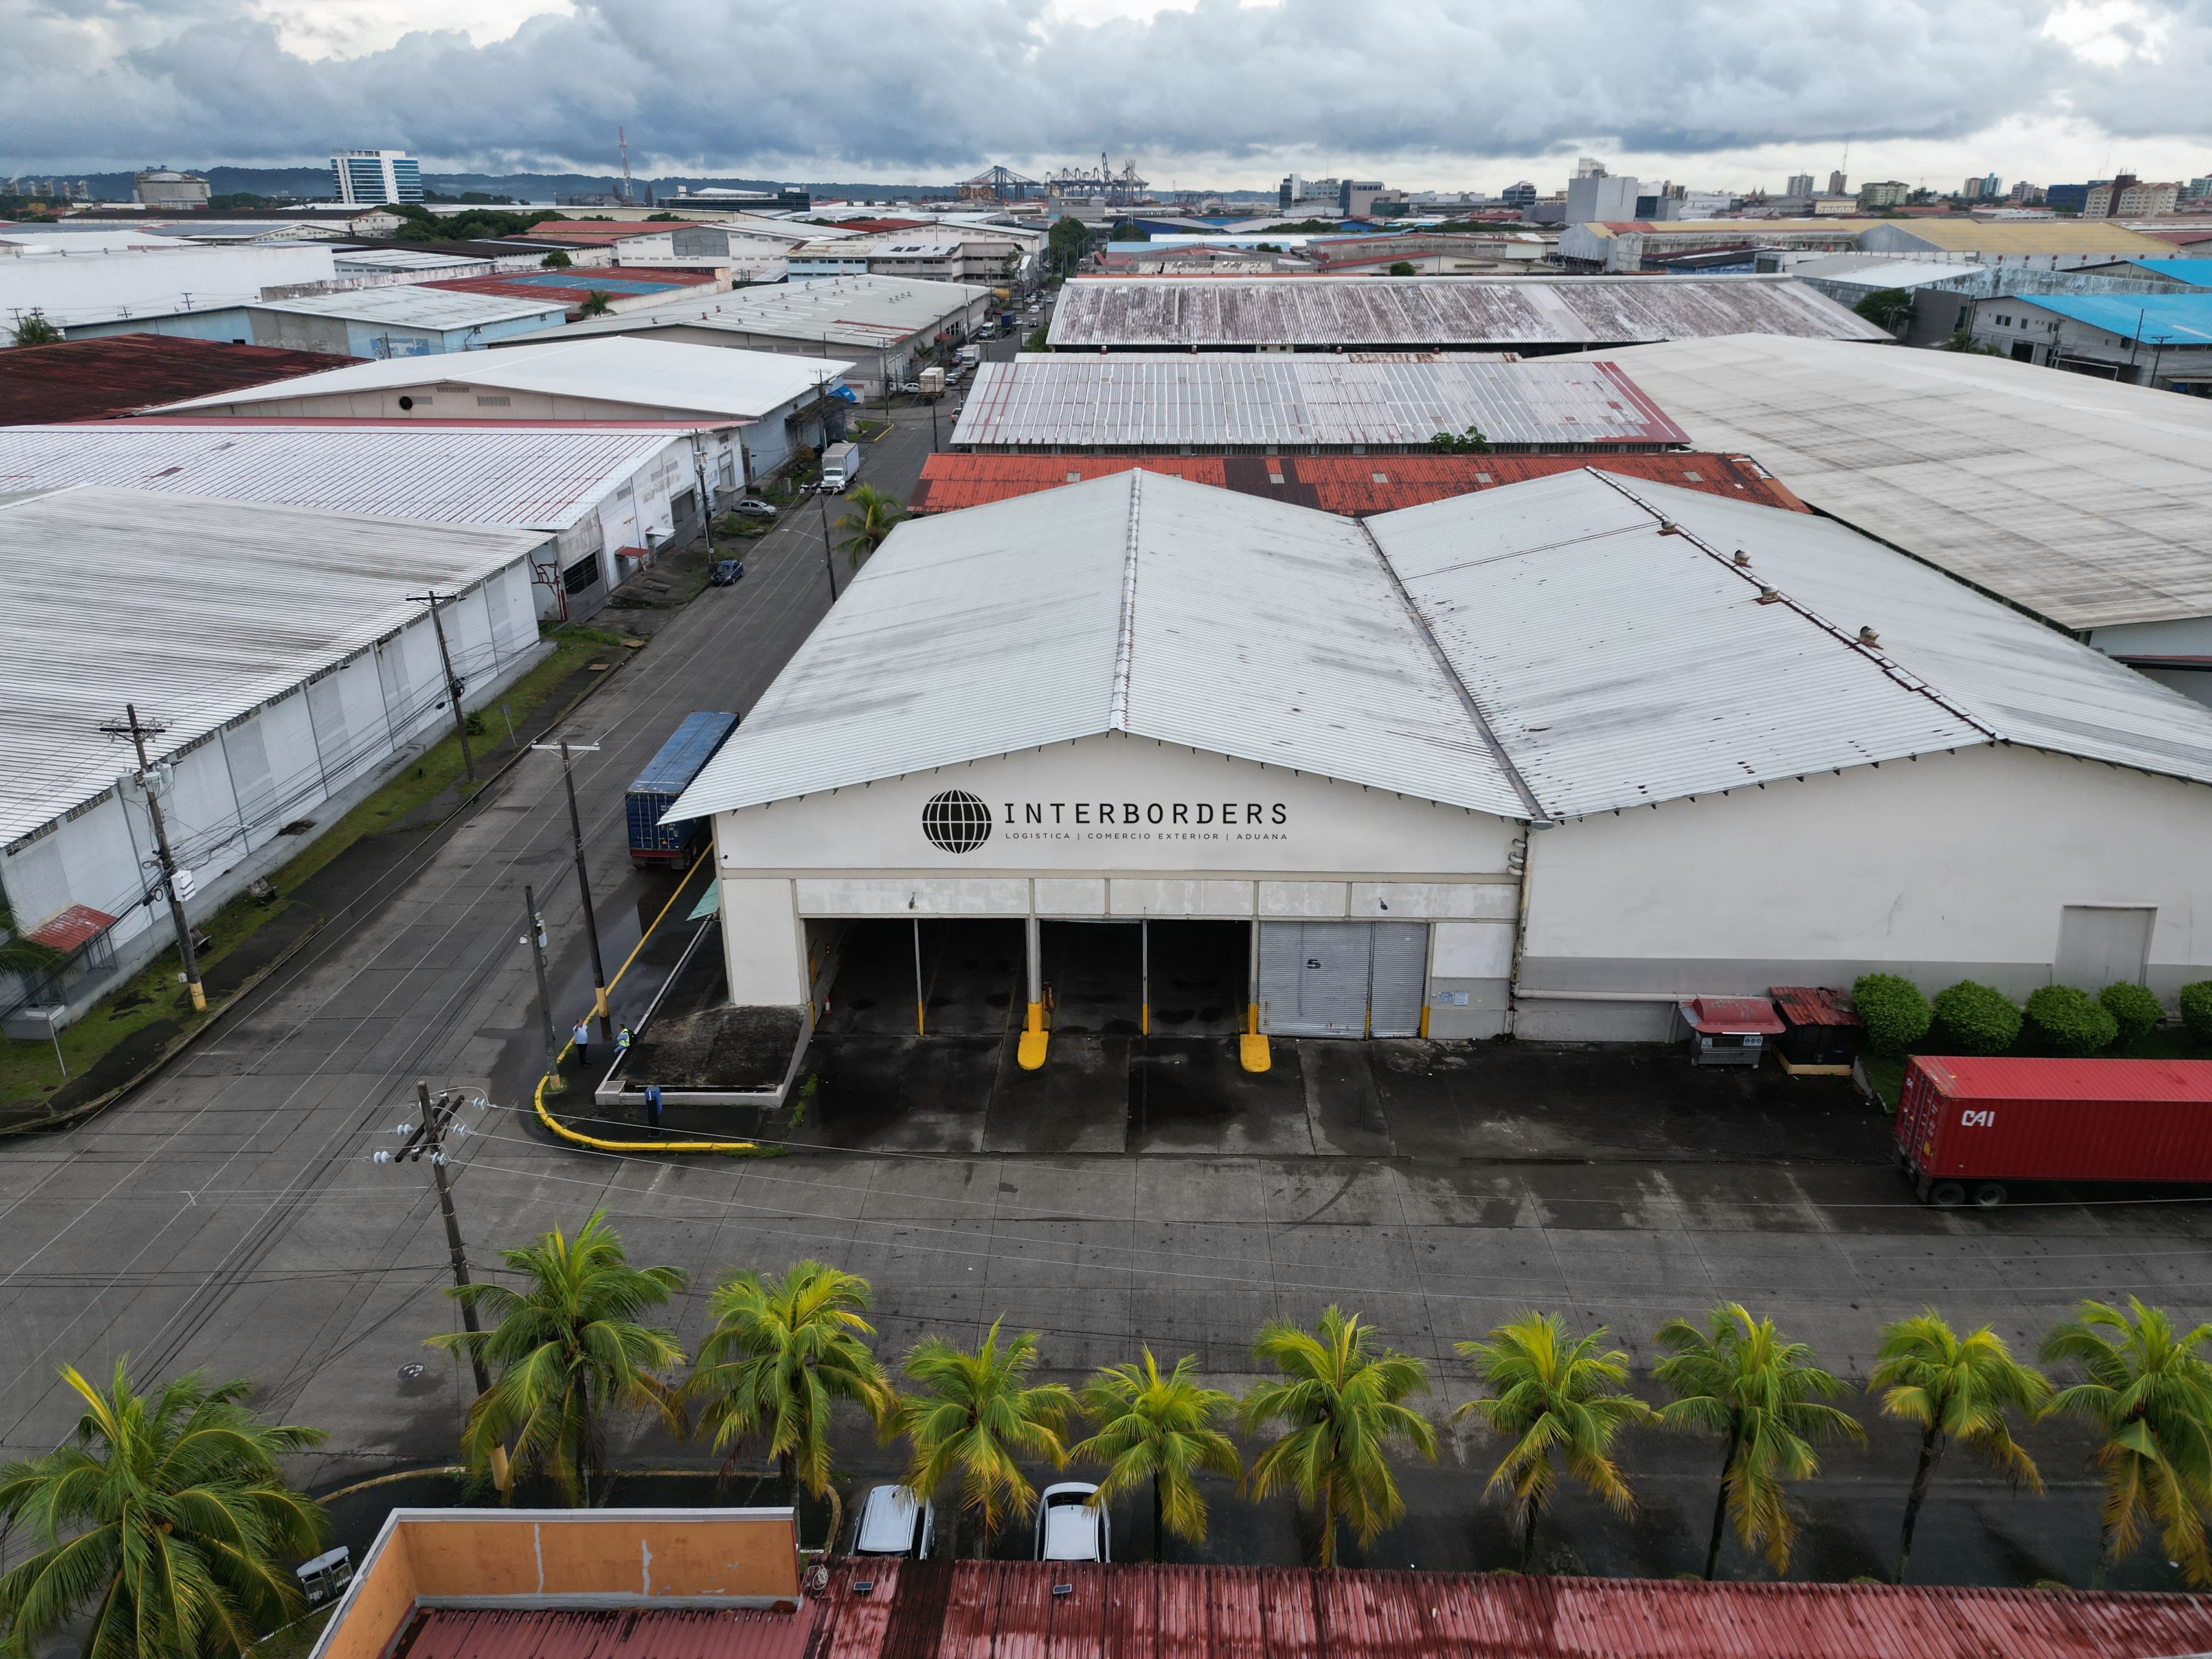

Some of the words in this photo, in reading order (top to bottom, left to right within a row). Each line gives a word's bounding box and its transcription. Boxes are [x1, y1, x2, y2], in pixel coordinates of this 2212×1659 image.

[1005, 803, 1287, 825] INTERBORDERS
[1306, 960, 1321, 969] 5
[1961, 1110, 1995, 1127] CAI
